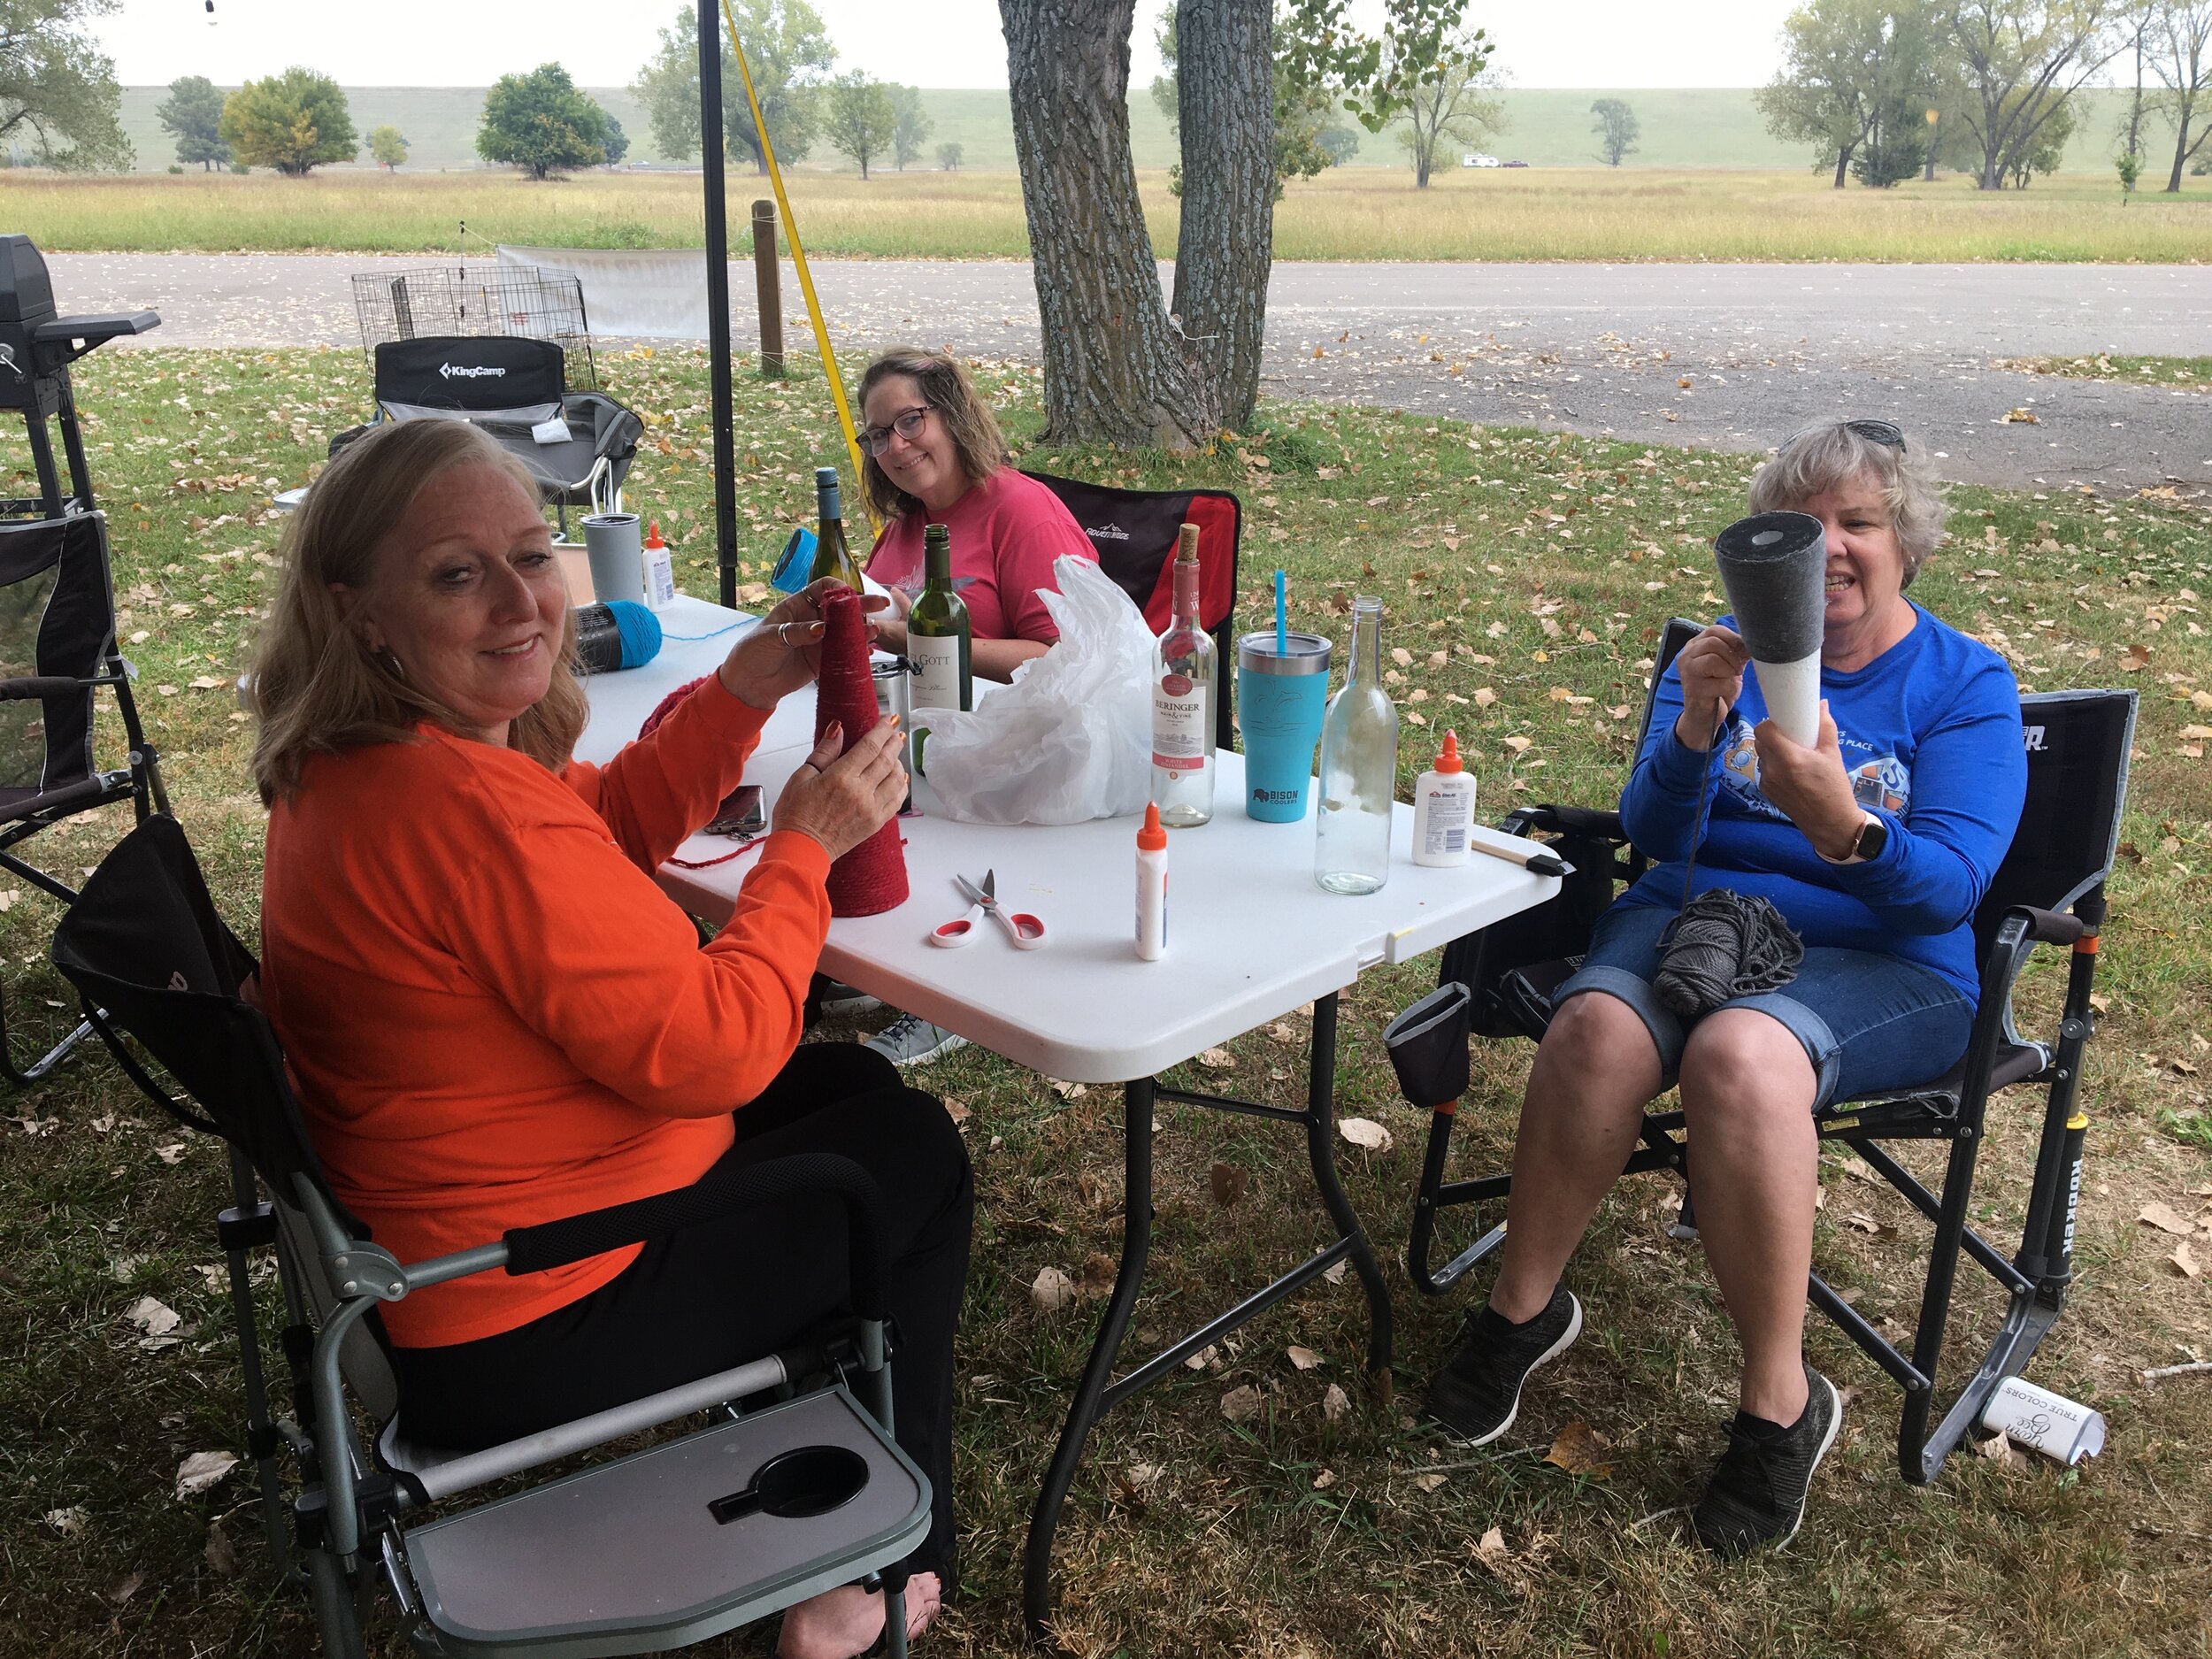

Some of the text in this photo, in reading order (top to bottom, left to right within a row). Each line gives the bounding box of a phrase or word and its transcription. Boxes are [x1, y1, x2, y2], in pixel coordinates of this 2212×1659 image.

[451, 366, 506, 378] KingCamp
[1155, 699, 1200, 711] BERINGER
[1846, 739, 1874, 751] PLACE
[1270, 790, 1298, 800] BISON
[2062, 1158, 2083, 1257] ROCKER
[2005, 1386, 2078, 1422] TRUE COLORS
